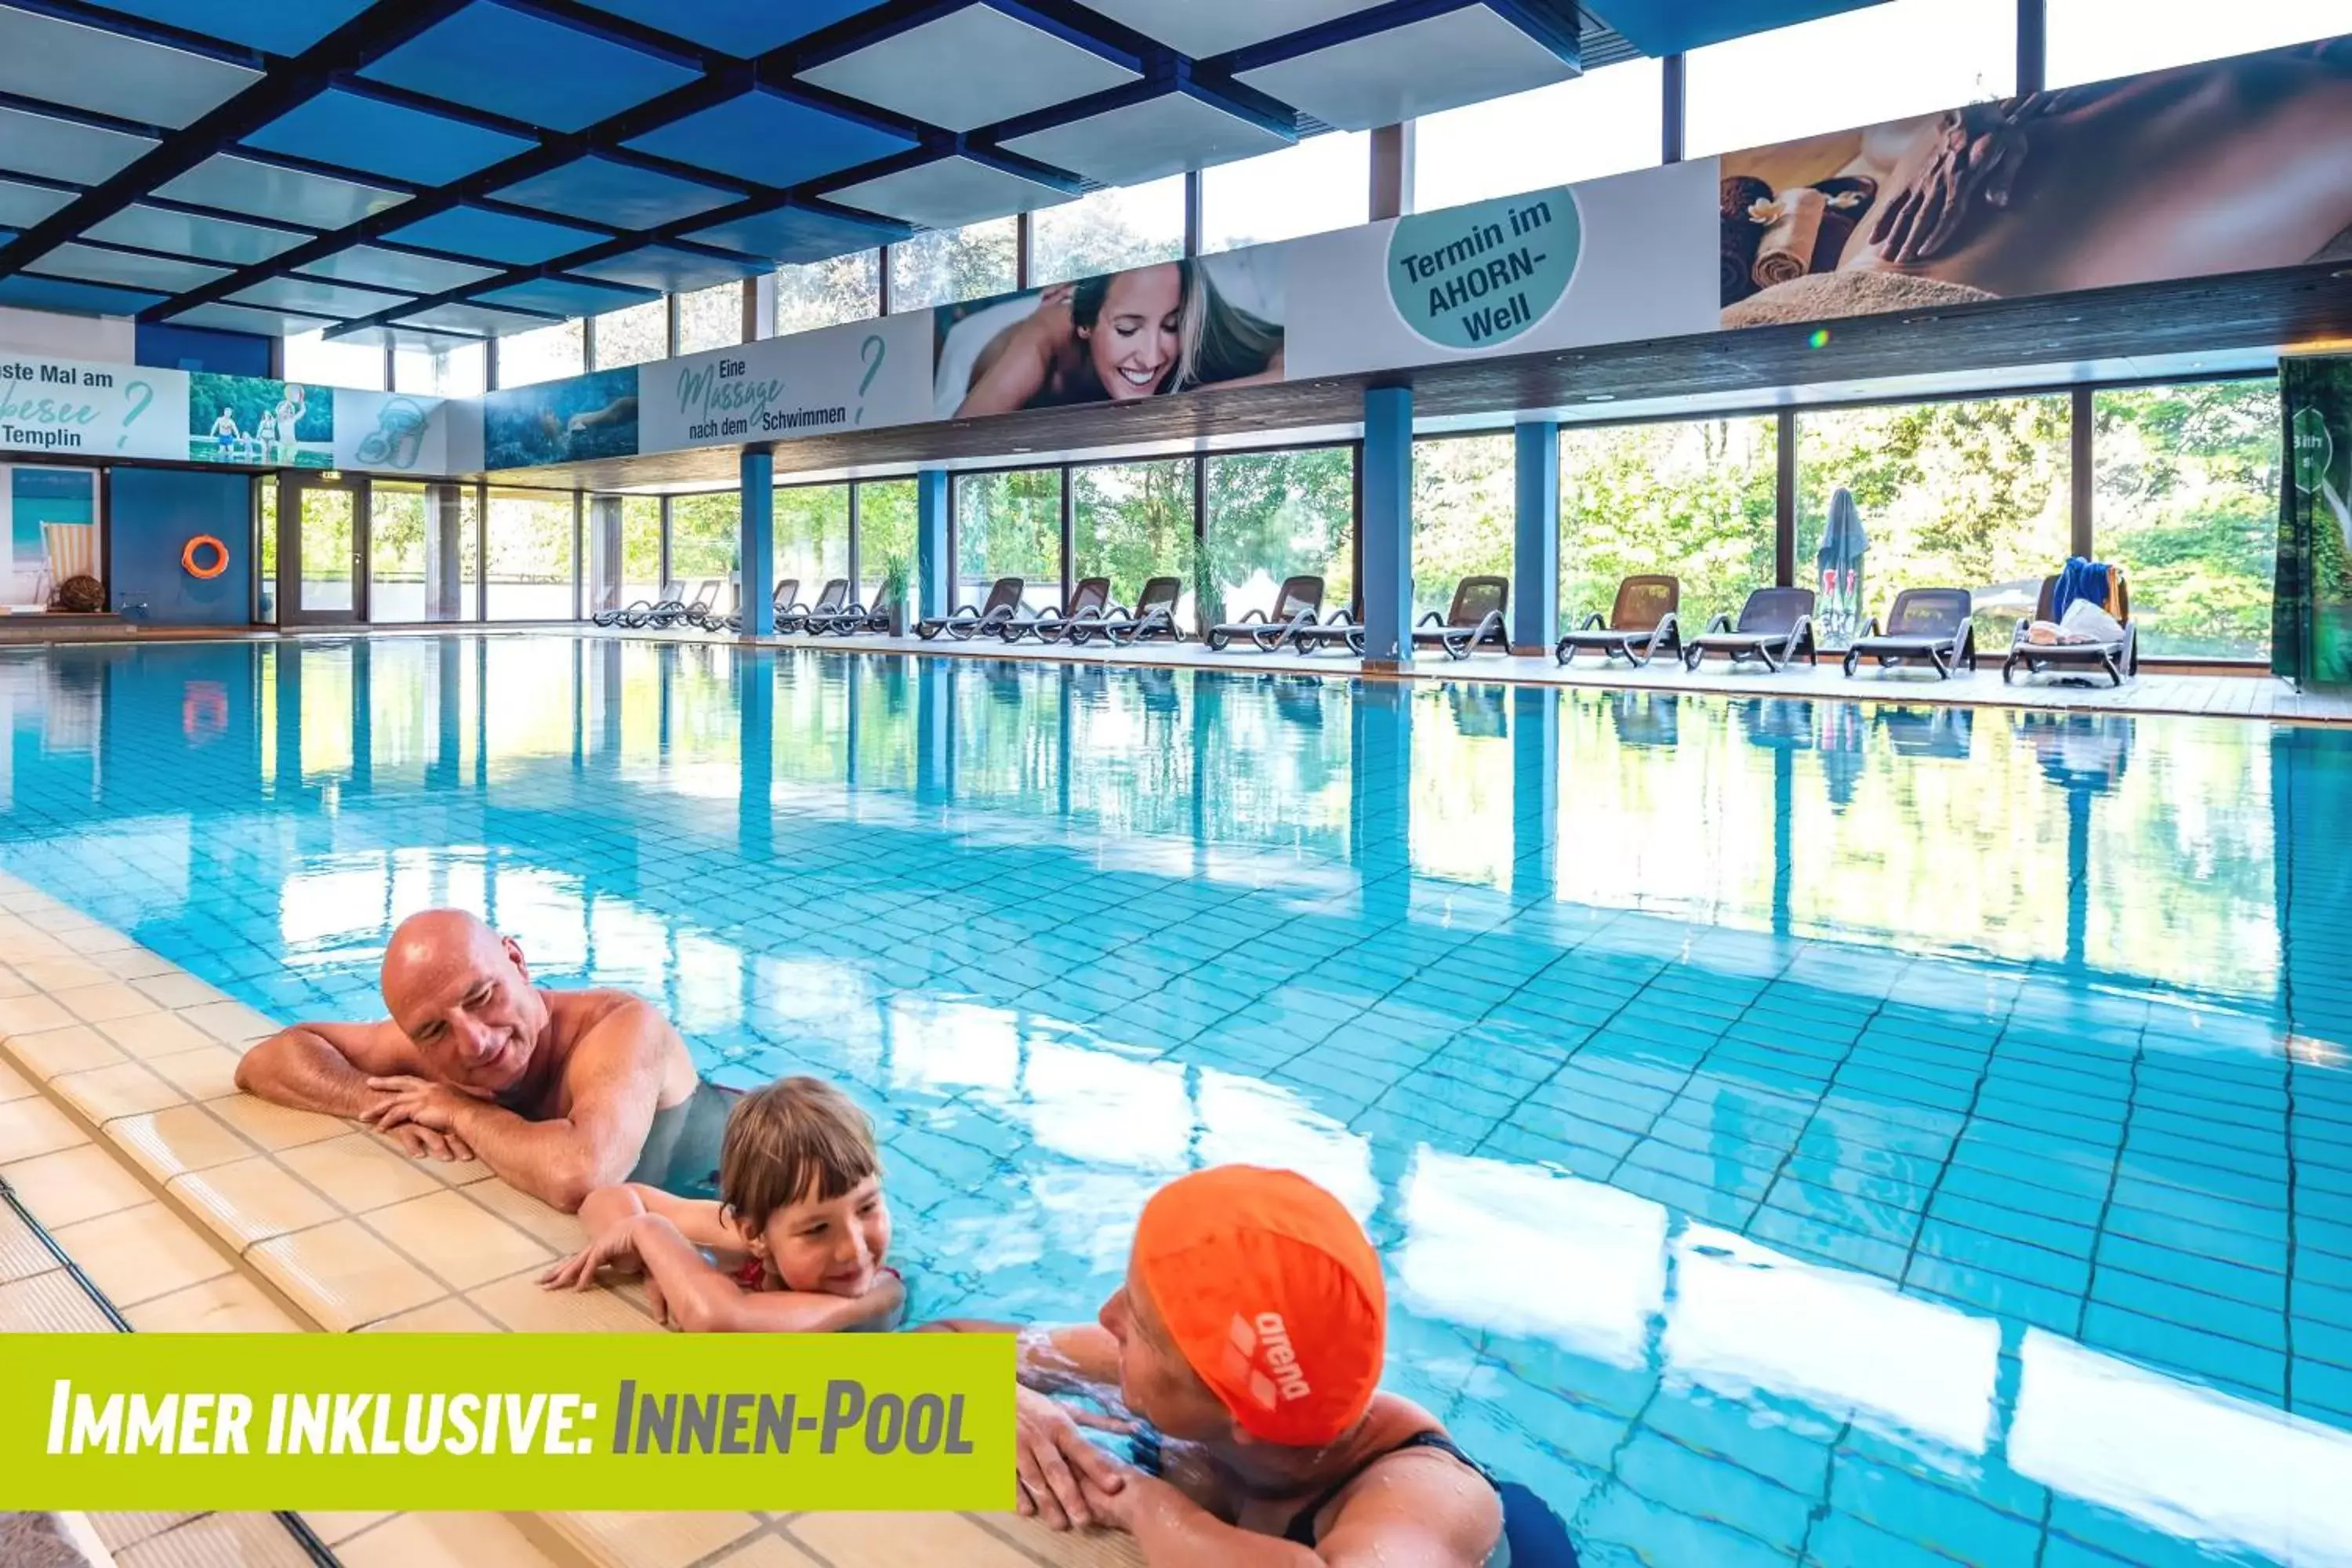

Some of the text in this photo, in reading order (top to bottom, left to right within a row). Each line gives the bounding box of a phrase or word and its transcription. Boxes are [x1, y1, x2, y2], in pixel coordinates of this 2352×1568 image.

[1399, 201, 1552, 285] Termin im
[1428, 246, 1548, 318] AHORN-
[1461, 291, 1532, 343] Well
[0, 362, 114, 389] ste Mal am
[677, 334, 886, 427] Massage ?
[719, 359, 746, 379] Eine
[2, 424, 82, 448] Templin
[116, 379, 154, 449] ?
[689, 405, 847, 440] nach dem Schwimmen
[1255, 1312, 1312, 1401] arena
